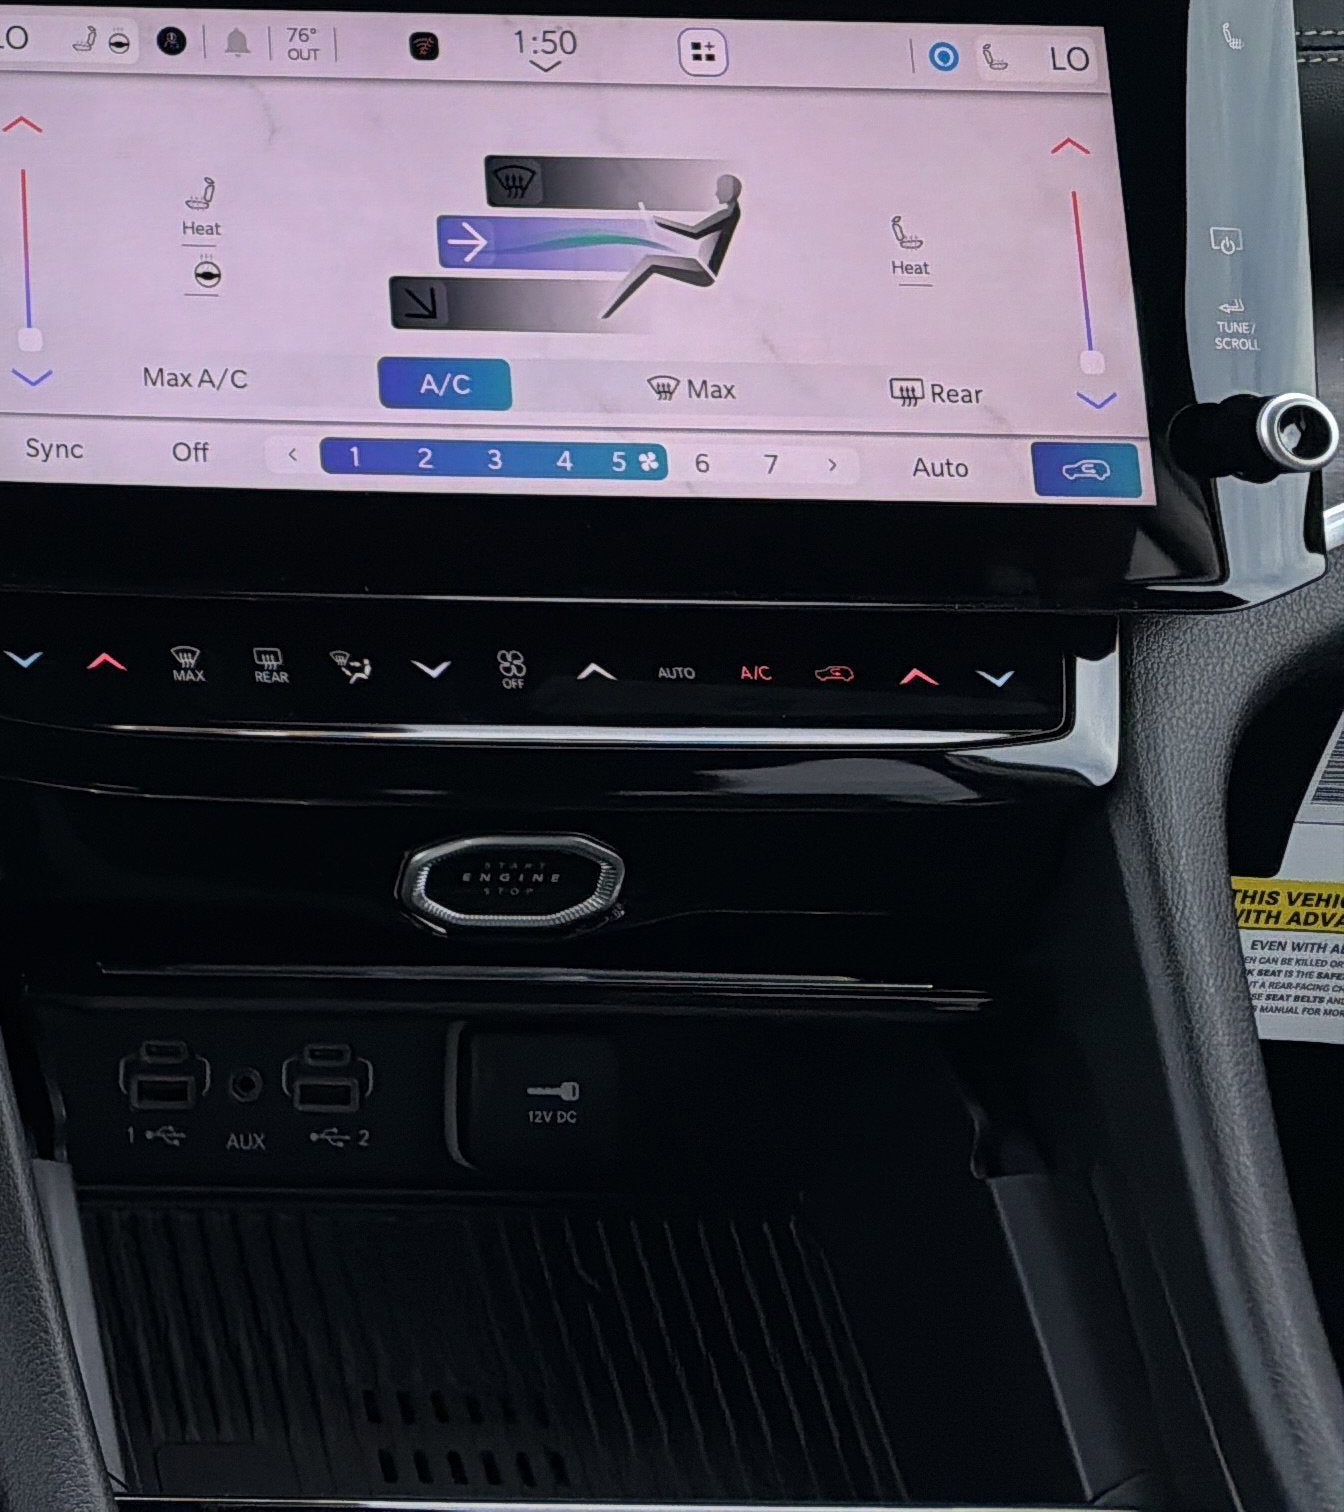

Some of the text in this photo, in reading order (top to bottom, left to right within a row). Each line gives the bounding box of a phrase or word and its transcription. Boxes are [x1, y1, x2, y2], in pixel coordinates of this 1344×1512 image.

[286, 27, 317, 43] 76°
[515, 30, 577, 55] 1:50
[287, 48, 320, 61] OUT
[1050, 46, 1091, 72] LO
[182, 221, 222, 237] Heat
[891, 260, 930, 276] Heat
[1215, 337, 1261, 351] SCROLL
[143, 367, 249, 391] Max A/C
[420, 374, 473, 396] A/C
[687, 379, 737, 401] Max
[931, 383, 983, 406] Rear
[25, 438, 84, 463] Sync
[172, 441, 210, 463] Off
[349, 447, 779, 475] 1 2 3 4 5 6 7
[912, 457, 969, 479] Auto
[172, 669, 206, 683] MAX
[255, 670, 289, 684] REAR
[658, 666, 696, 680] AUTO
[740, 665, 772, 681] A/C
[502, 678, 524, 690] OFF
[462, 872, 560, 883] ENGINE
[1287, 891, 1344, 908] VEHI
[1250, 940, 1288, 951] EVEN
[1292, 941, 1328, 954] WITH
[1259, 957, 1279, 965] CAN
[1280, 958, 1293, 966] BE
[1295, 958, 1328, 968] KILLED
[1257, 969, 1283, 978] SEAT
[1284, 970, 1294, 978] IS
[1297, 970, 1315, 979] THE
[1265, 994, 1292, 1002] SEAT
[1293, 995, 1325, 1004] BELTS
[1260, 1005, 1300, 1015] MANUAL
[1302, 1007, 1321, 1016] FOR
[528, 1110, 577, 1124] 12V DC
[226, 1133, 266, 1151] AUX
[358, 1130, 370, 1145] 2
